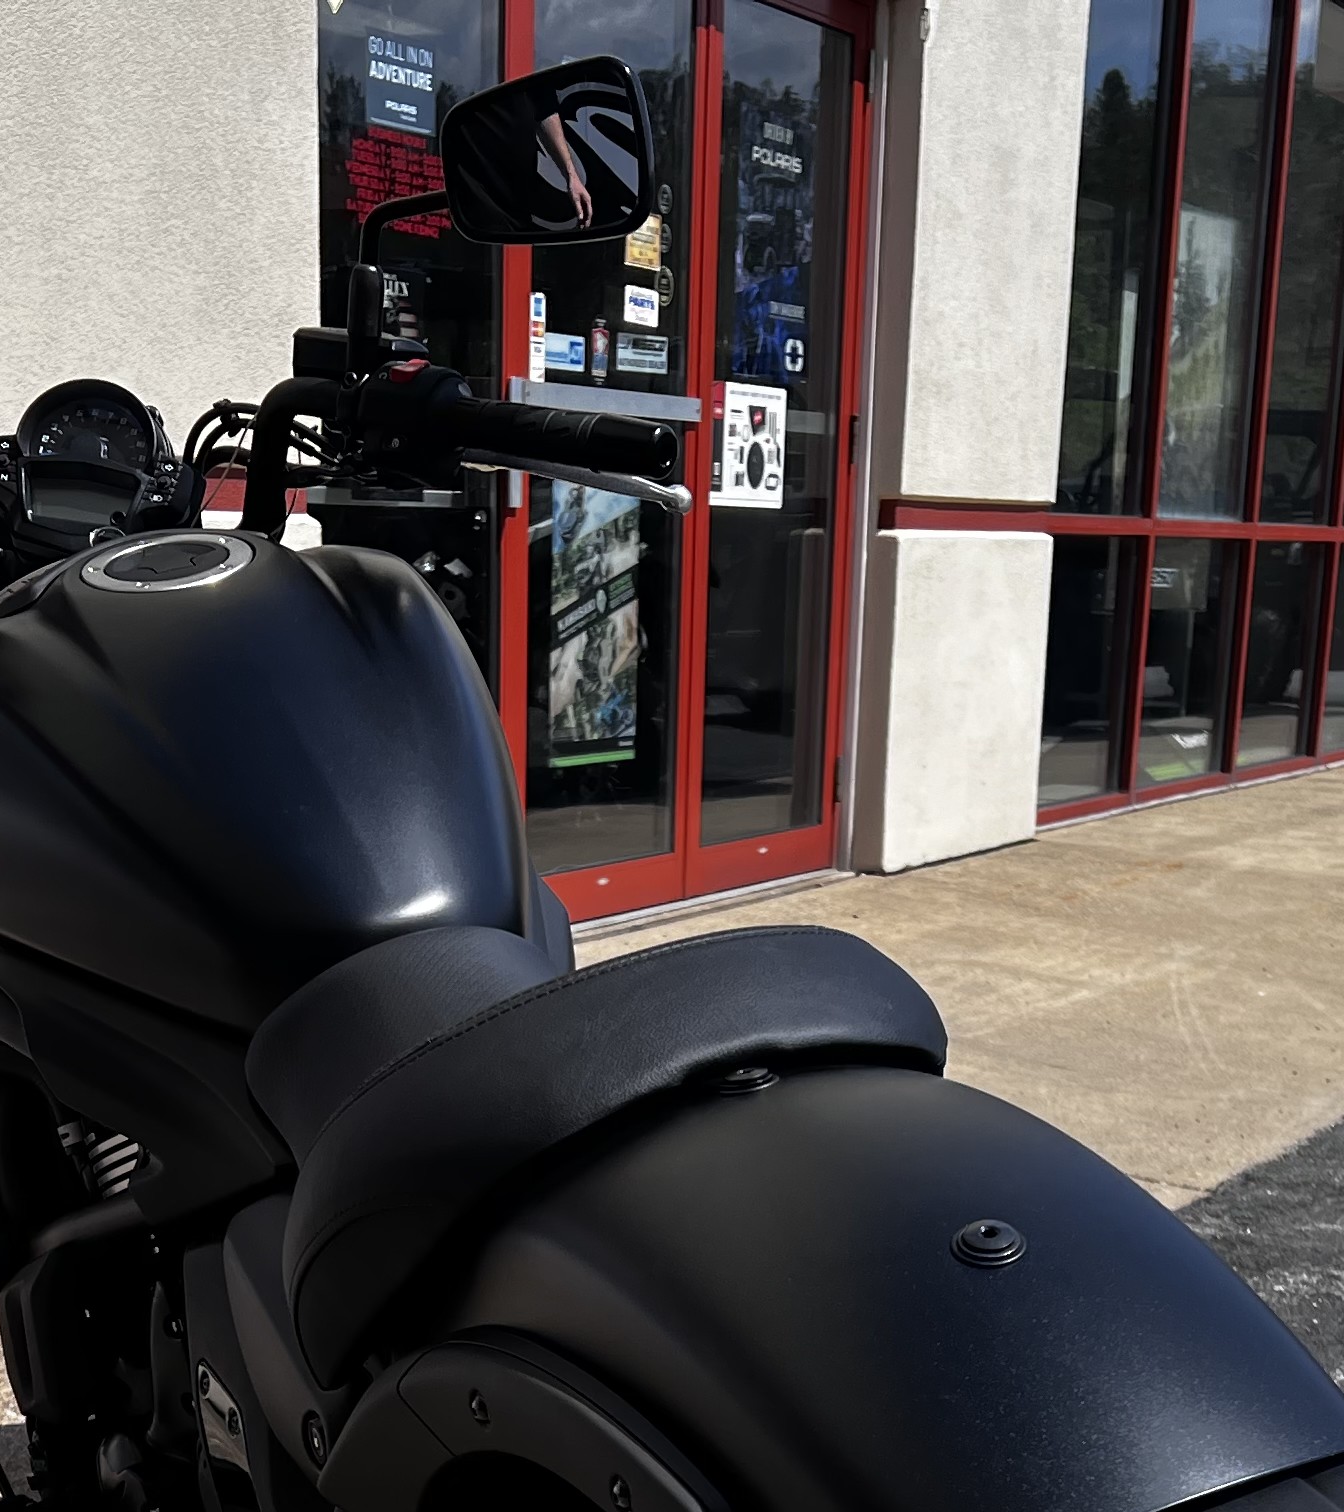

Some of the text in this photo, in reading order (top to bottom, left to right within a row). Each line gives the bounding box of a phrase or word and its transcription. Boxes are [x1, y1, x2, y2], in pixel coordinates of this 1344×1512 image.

[368, 35, 433, 69] GO ALL IN ON
[369, 60, 433, 91] ADVENTURE
[384, 100, 418, 115] POLARIS
[751, 145, 803, 174] POLARIS
